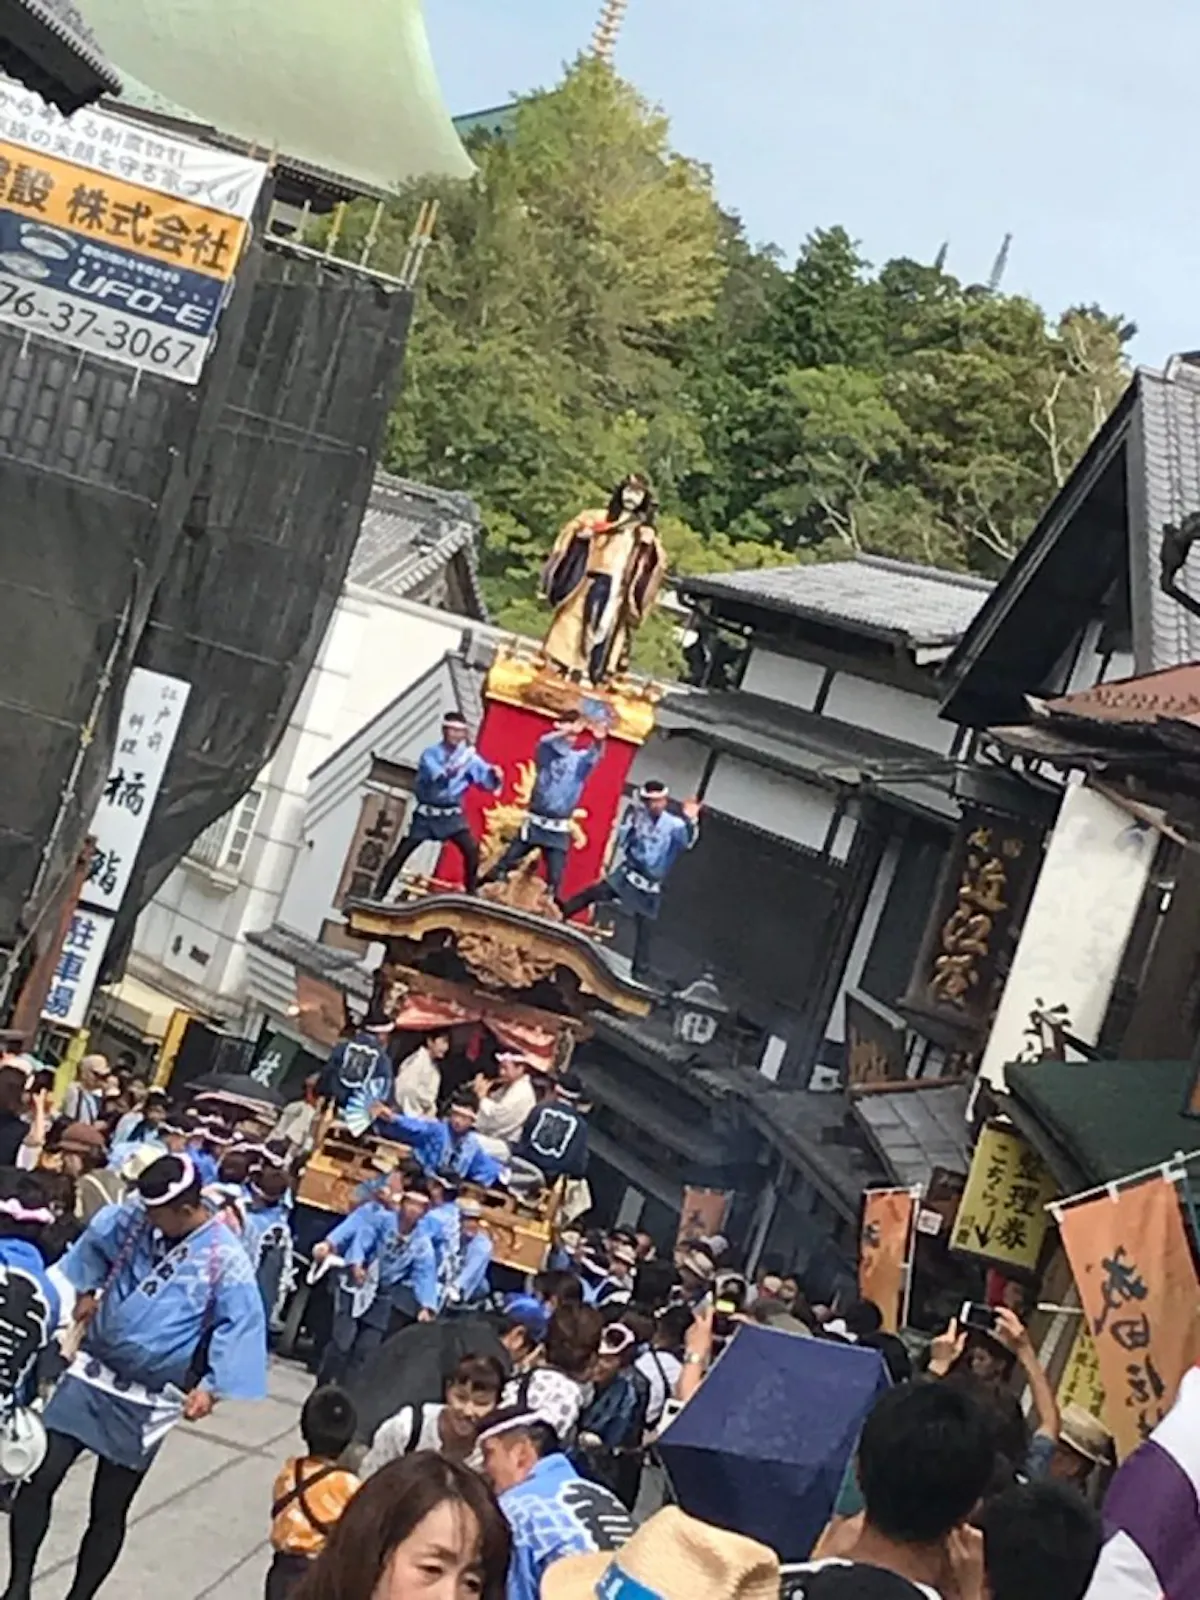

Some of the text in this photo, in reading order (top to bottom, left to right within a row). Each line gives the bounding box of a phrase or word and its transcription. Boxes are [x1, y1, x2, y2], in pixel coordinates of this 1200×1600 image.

[66, 182, 230, 272] 株式会社
[68, 268, 212, 329] UFO-E
[45, 914, 97, 1019] 駐車場
[981, 1143, 1010, 1208] こちら
[996, 1151, 1046, 1251] 整理券
